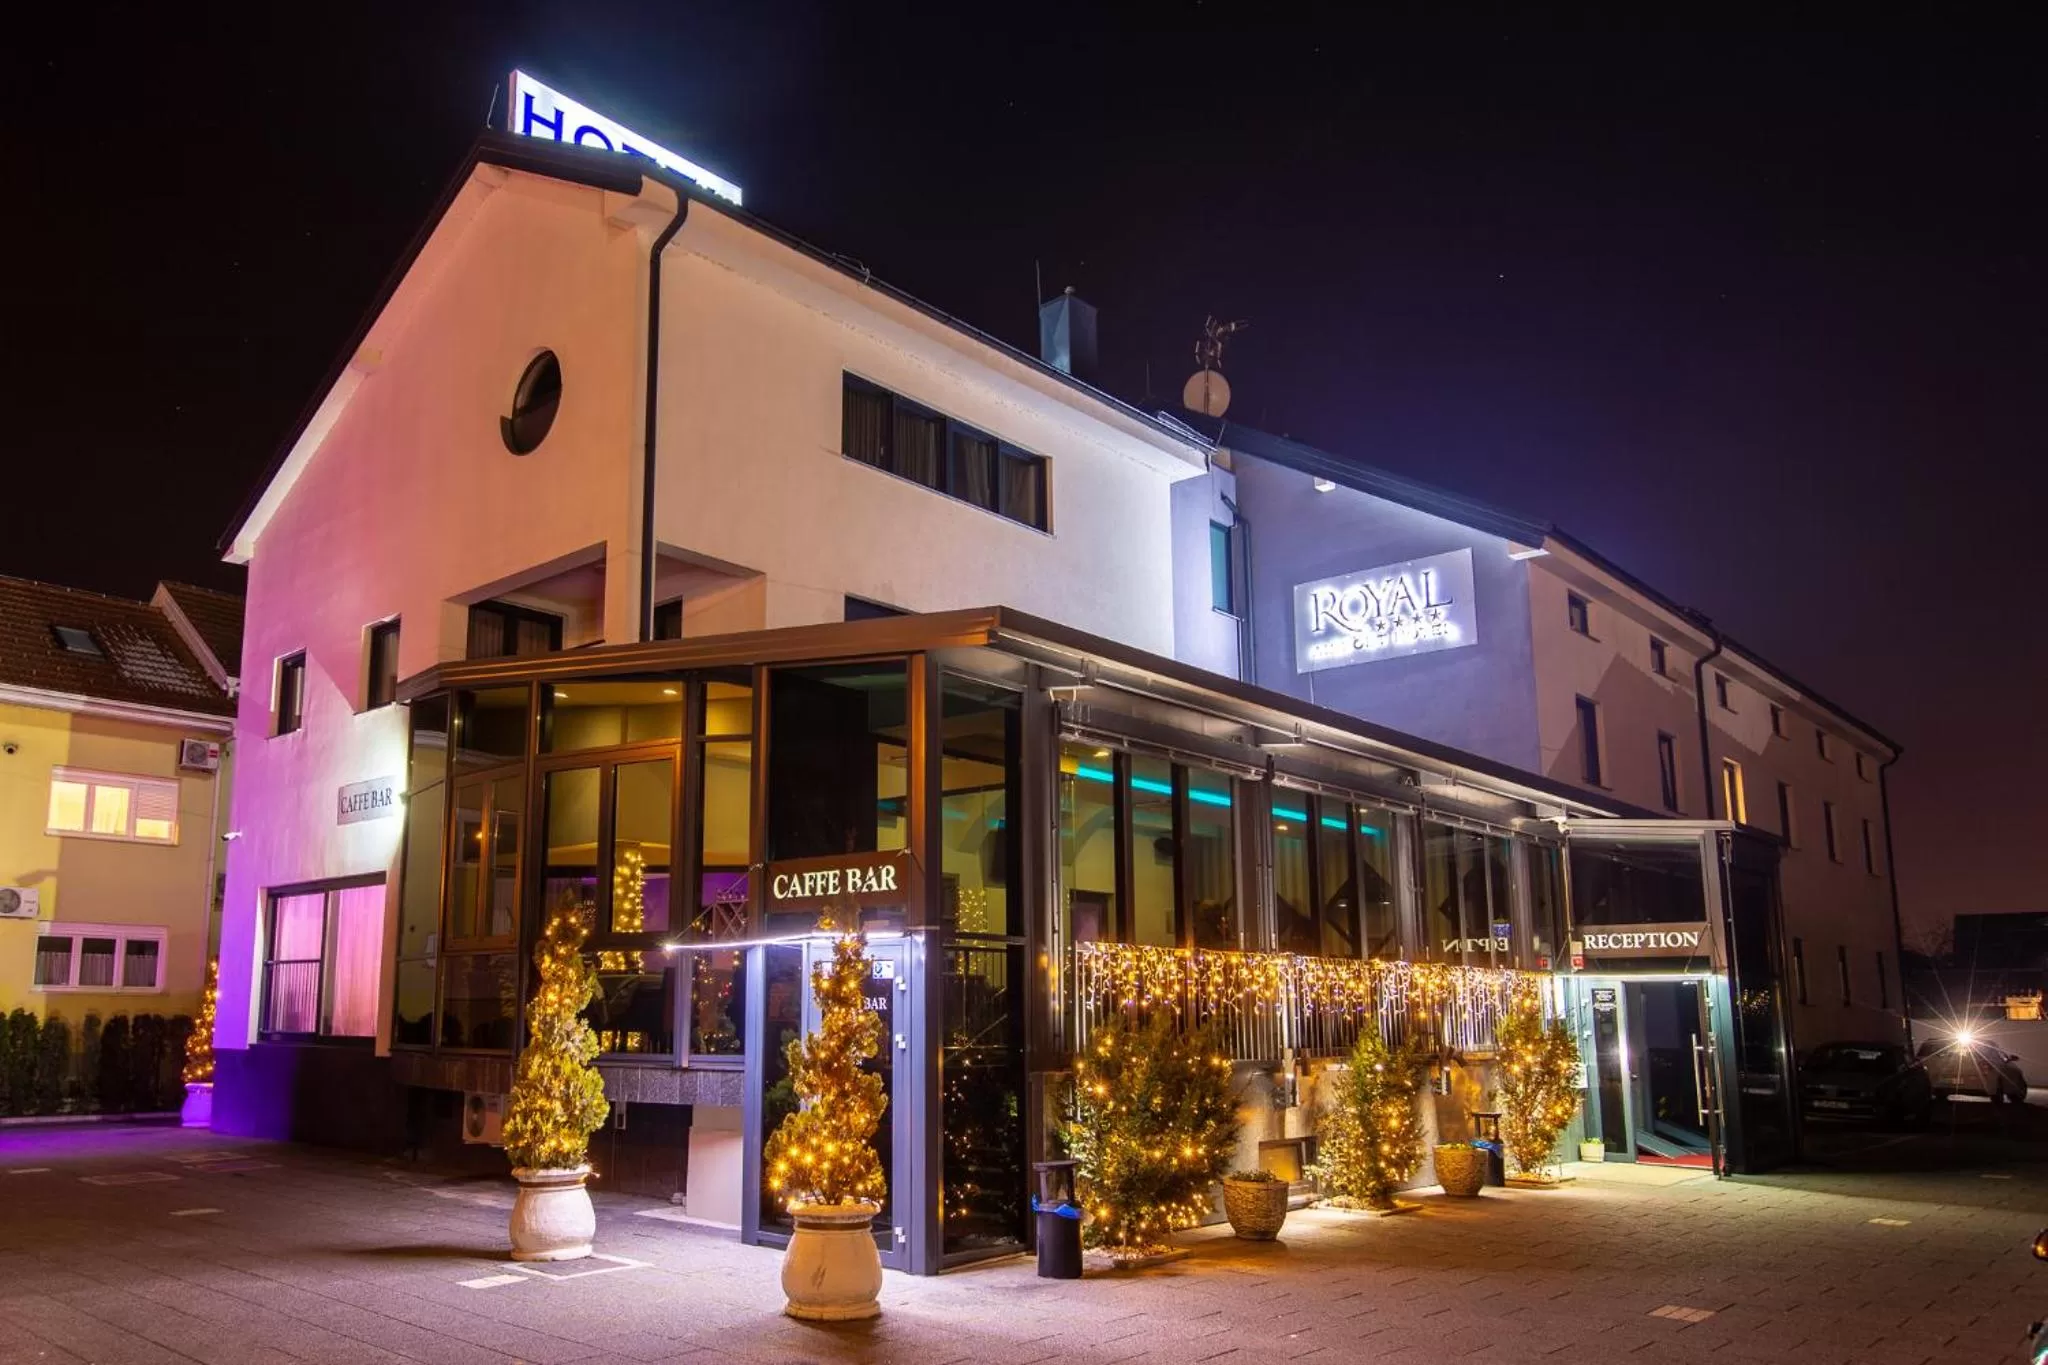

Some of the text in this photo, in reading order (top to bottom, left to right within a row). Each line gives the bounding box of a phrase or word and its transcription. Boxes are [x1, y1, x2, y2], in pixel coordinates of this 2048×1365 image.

[1311, 570, 1454, 633] ROYAL
[340, 787, 392, 814] CAFFE BAR
[773, 864, 898, 899] CAFFE BAR
[1583, 931, 1699, 949] RECEPTION
